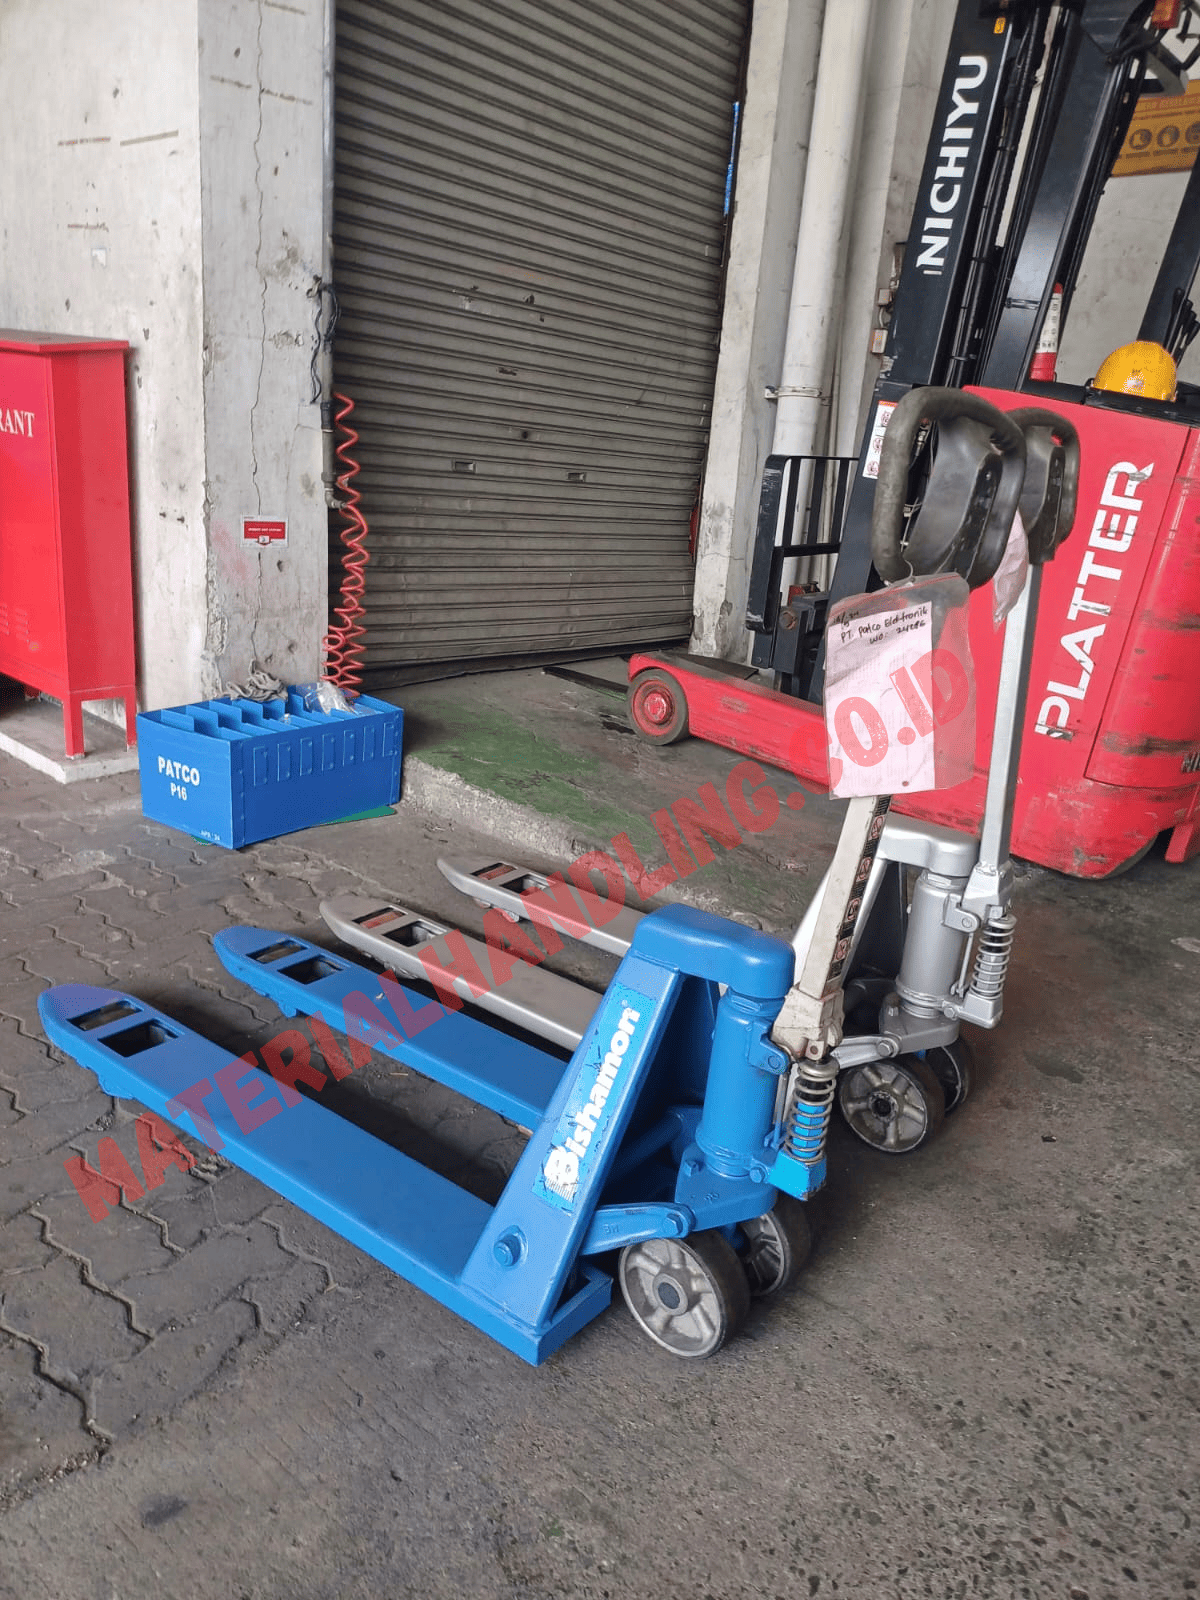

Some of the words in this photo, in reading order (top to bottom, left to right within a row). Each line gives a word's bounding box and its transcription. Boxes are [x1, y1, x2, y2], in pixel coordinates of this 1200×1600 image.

[915, 55, 988, 268] NICHIYU
[1034, 461, 1154, 741] PLATTER
[157, 755, 200, 786] PATCO
[544, 1007, 641, 1204] Bishamon
